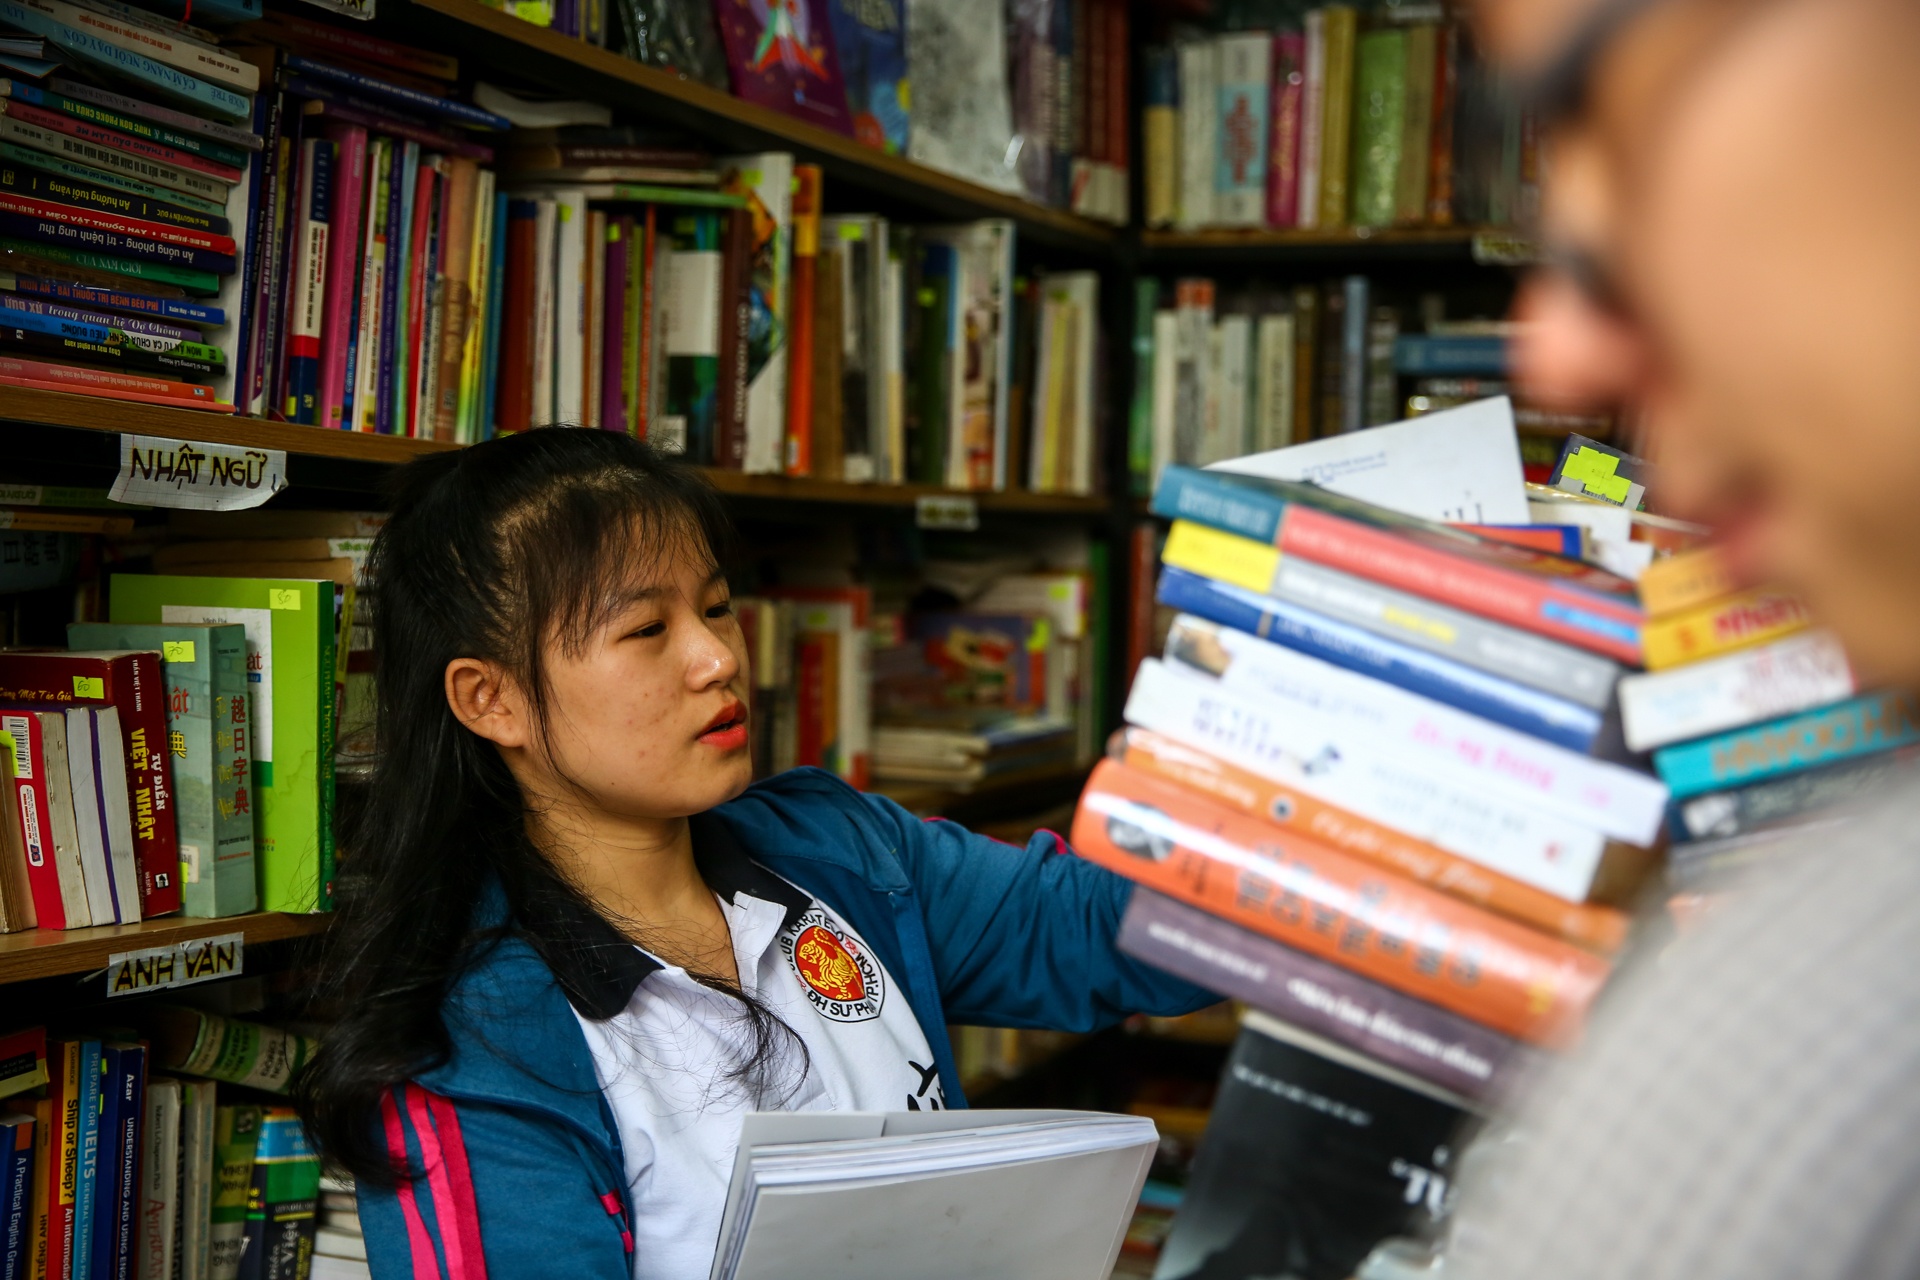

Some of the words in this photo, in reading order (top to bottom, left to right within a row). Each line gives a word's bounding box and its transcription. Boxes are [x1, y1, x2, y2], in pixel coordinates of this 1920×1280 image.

[60, 27, 88, 45] CON
[139, 58, 171, 78] NANG
[151, 128, 160, 139] &
[132, 141, 162, 155] THÁNG
[88, 171, 99, 180] CAO
[48, 180, 72, 195] vàng
[71, 187, 90, 200] tuổi
[89, 189, 117, 207] hưởng
[38, 222, 55, 235] thư
[44, 210, 67, 221] MẸO
[92, 217, 125, 230] THUỐC
[126, 225, 147, 235] HAY
[58, 225, 77, 237] ung
[79, 229, 104, 243] bệnh
[106, 233, 117, 246] trị
[124, 237, 155, 254] phòng
[98, 257, 119, 270] NAM
[156, 244, 180, 262] uống
[71, 288, 95, 301] THUỐC
[96, 292, 109, 304] TRỊ
[109, 294, 130, 307] BỆNH
[129, 297, 145, 310] BÉO
[145, 300, 159, 312] PHÌ
[47, 304, 78, 320] trong
[81, 312, 110, 325] quan
[111, 315, 125, 328] hệ
[108, 330, 129, 344] BỆNH
[183, 345, 202, 358] MÓN
[130, 443, 205, 490] NHẬT
[210, 451, 268, 489] NGỮ
[132, 659, 140, 675] TRẦN
[77, 680, 90, 691] 60
[132, 676, 141, 689] VIỆT
[18, 688, 36, 699] Một
[38, 689, 55, 700] Tác
[56, 690, 72, 701] Giả
[133, 692, 142, 711] THANH
[127, 727, 150, 771] VIỆT
[231, 695, 250, 816] 越日字典
[153, 775, 169, 810] ĐIỂN
[132, 787, 157, 841] NHẬT
[115, 952, 175, 992] ANH
[184, 940, 235, 978] VĂN
[807, 990, 828, 1011] ĐH
[830, 1002, 852, 1017] SƯ
[69, 1045, 77, 1084] CAMBRIDGE
[87, 1052, 98, 1102] PREPARE
[125, 1073, 134, 1101] Azar
[63, 1099, 77, 1130] Ship
[86, 1105, 95, 1126] FOR
[65, 1132, 74, 1146] or
[16, 1156, 27, 1165] A
[83, 1130, 96, 1178] IELTS
[122, 1116, 134, 1197] UNDERSTANDING
[61, 1148, 76, 1197] Sheep?
[11, 1166, 26, 1211] Practical
[81, 1181, 89, 1220] GENERAL
[120, 1200, 130, 1221] AND
[64, 1208, 73, 1221] An
[4, 1213, 20, 1249] English
[39, 1214, 47, 1237] ANH
[79, 1223, 87, 1262] TRAINING
[119, 1223, 129, 1253] USING
[144, 1199, 165, 1278] AMERICAN
[280, 1220, 301, 1264] Việt
[35, 1239, 46, 1273] TIẾNG
